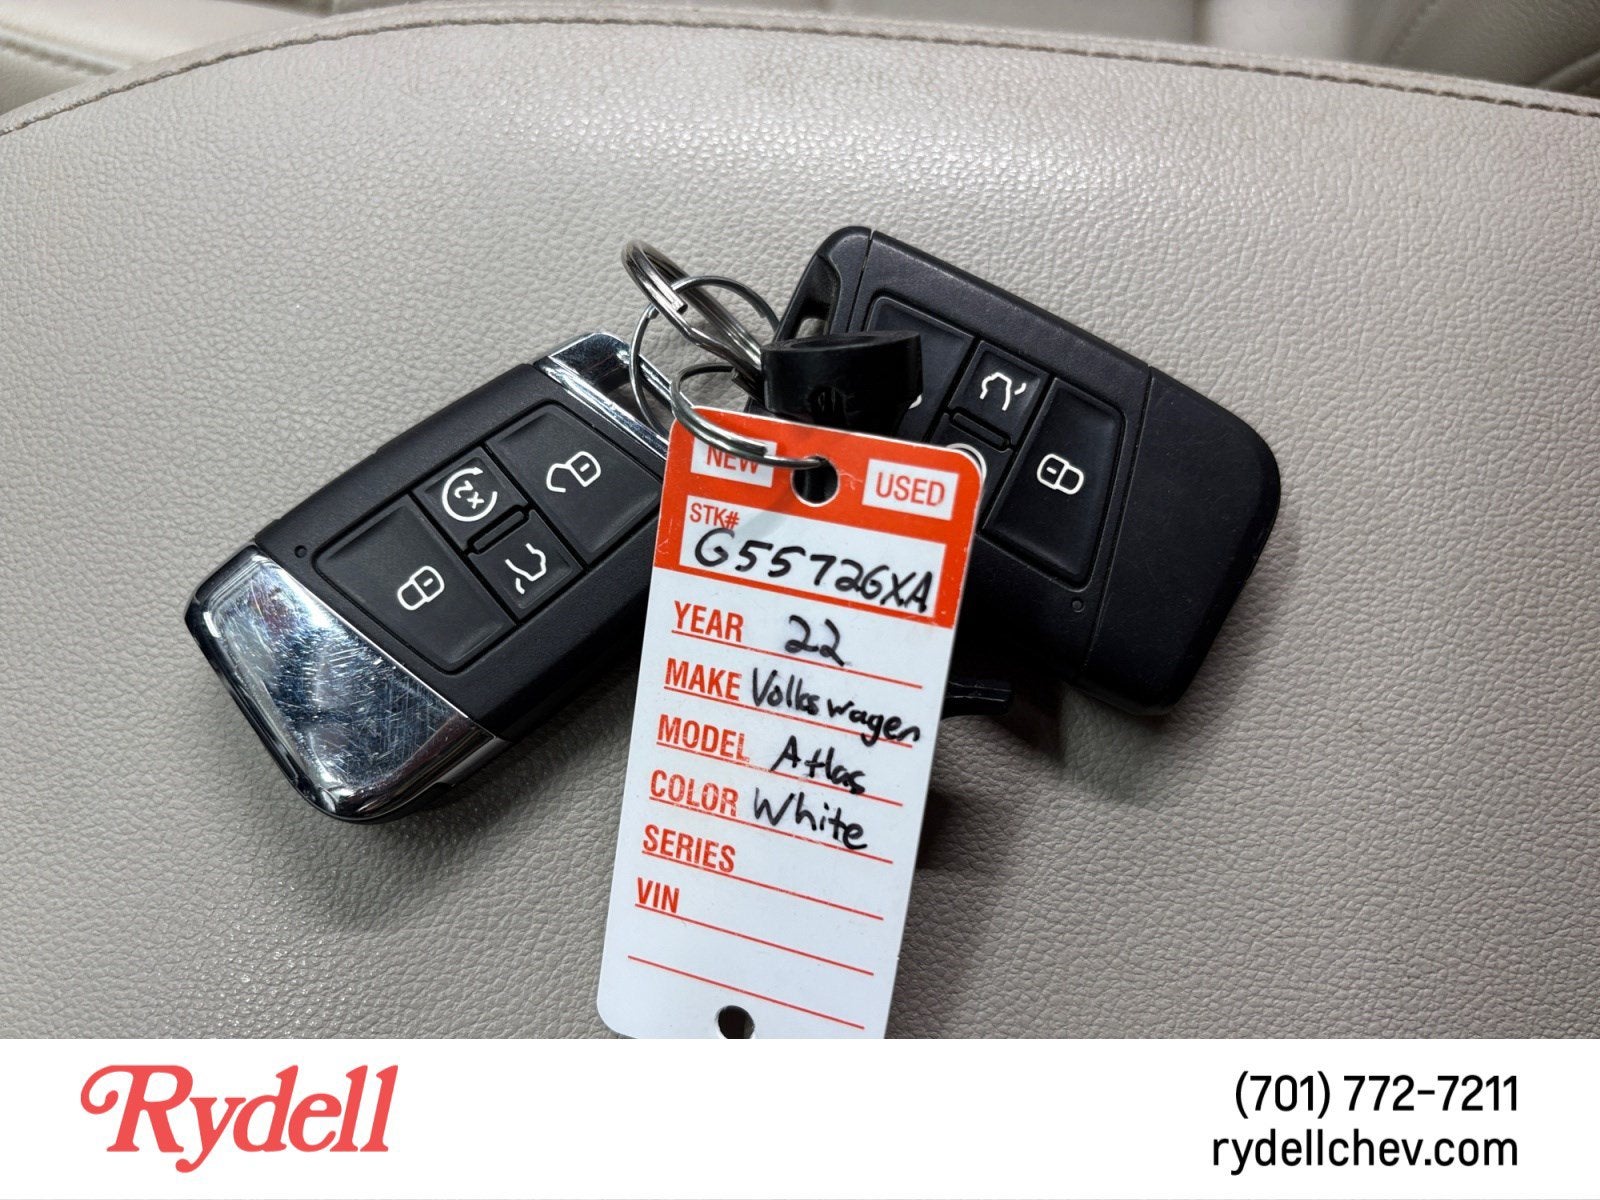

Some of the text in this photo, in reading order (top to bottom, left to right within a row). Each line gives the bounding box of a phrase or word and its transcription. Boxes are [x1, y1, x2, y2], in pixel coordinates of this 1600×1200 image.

[706, 444, 759, 475] NEW
[875, 472, 945, 507] USED
[689, 502, 740, 529] STK#
[674, 601, 744, 642] YEAR
[784, 614, 845, 667] 22
[665, 658, 742, 700] MAKE
[657, 714, 750, 763] MODEL
[769, 734, 866, 795] Atlas
[650, 769, 739, 816] COLOR
[753, 787, 868, 849] White
[642, 824, 736, 873] SERIES
[636, 877, 680, 914] VIN
